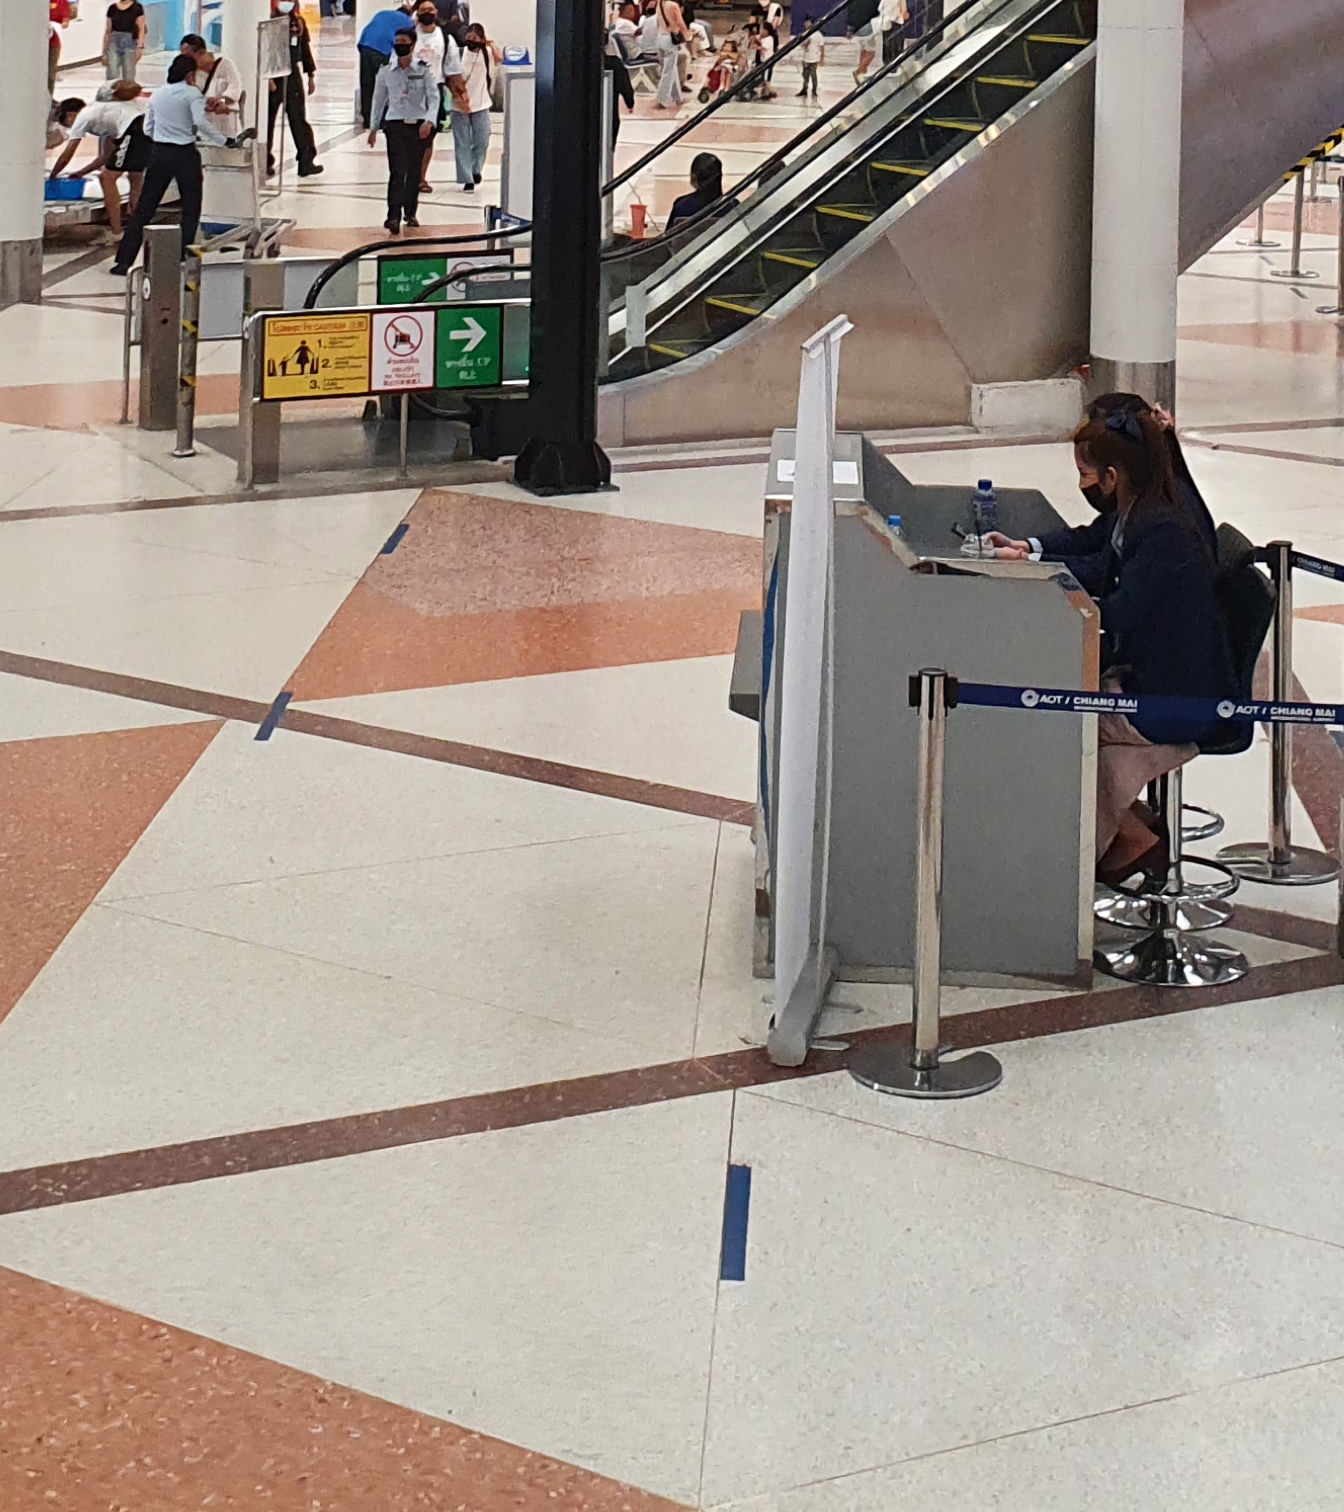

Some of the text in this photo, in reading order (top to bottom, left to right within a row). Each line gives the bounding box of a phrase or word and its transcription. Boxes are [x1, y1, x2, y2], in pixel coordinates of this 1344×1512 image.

[1040, 694, 1063, 704] AOT
[1073, 696, 1115, 706] CHIANG
[1117, 699, 1138, 708] MAI
[1236, 705, 1259, 714] AOT
[1270, 707, 1313, 716] CHIANG
[1315, 708, 1336, 717] MAI
